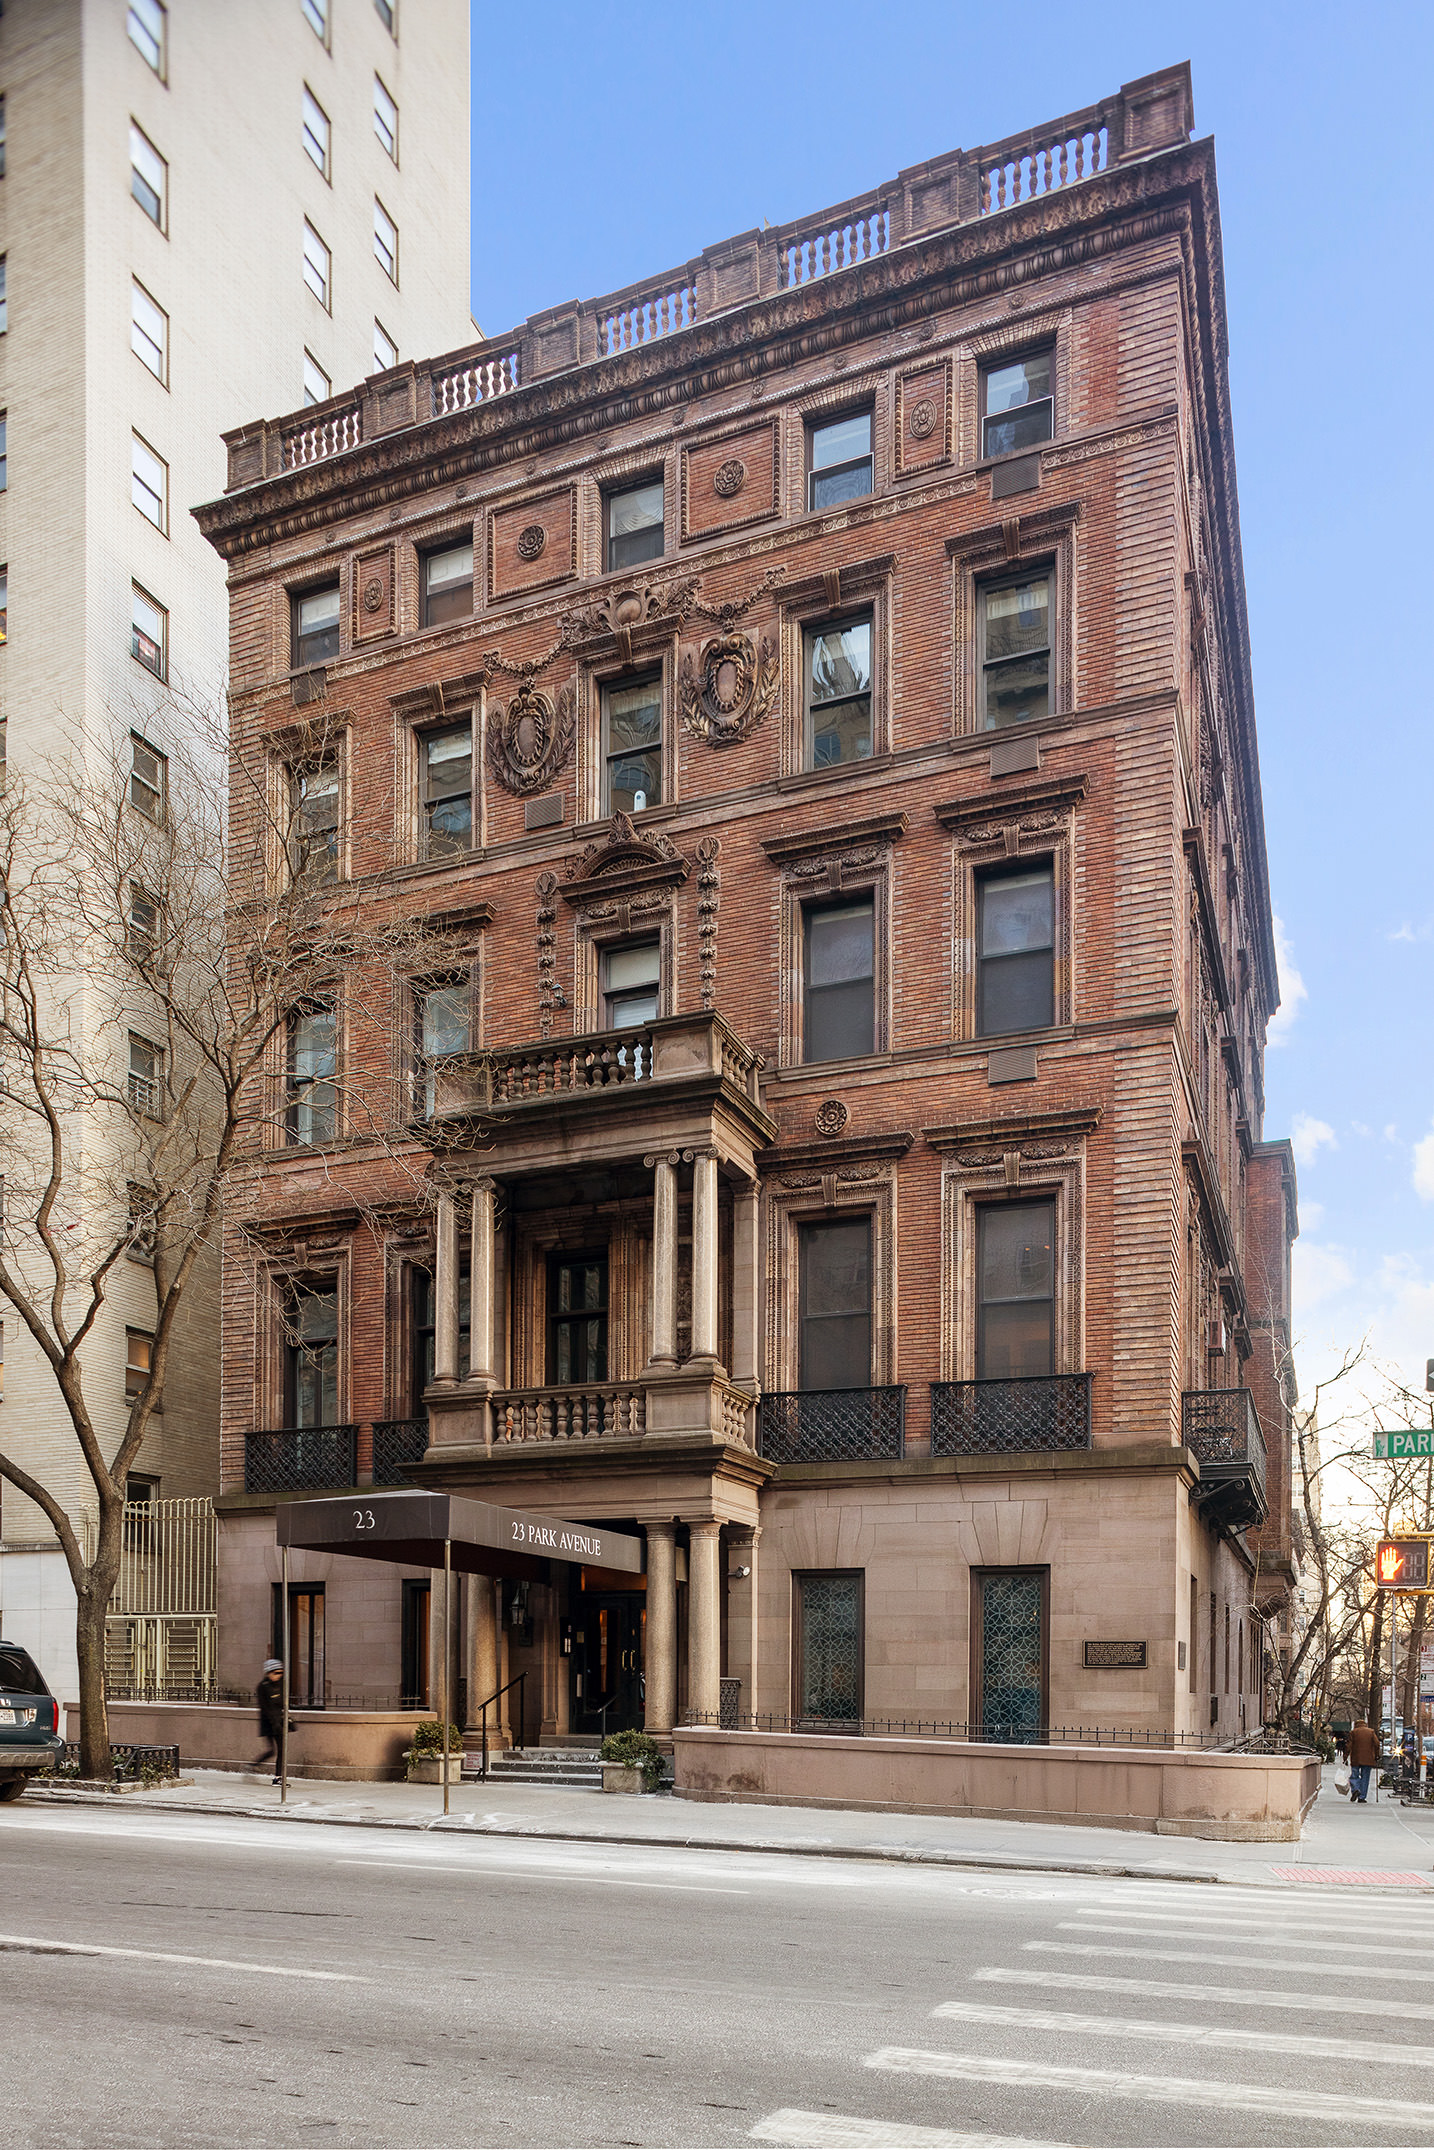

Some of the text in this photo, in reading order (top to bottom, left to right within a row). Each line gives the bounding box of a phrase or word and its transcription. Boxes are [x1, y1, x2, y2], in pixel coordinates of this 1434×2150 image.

[353, 1510, 375, 1529] 23
[511, 1521, 601, 1556] 23 PARK AVENUE
